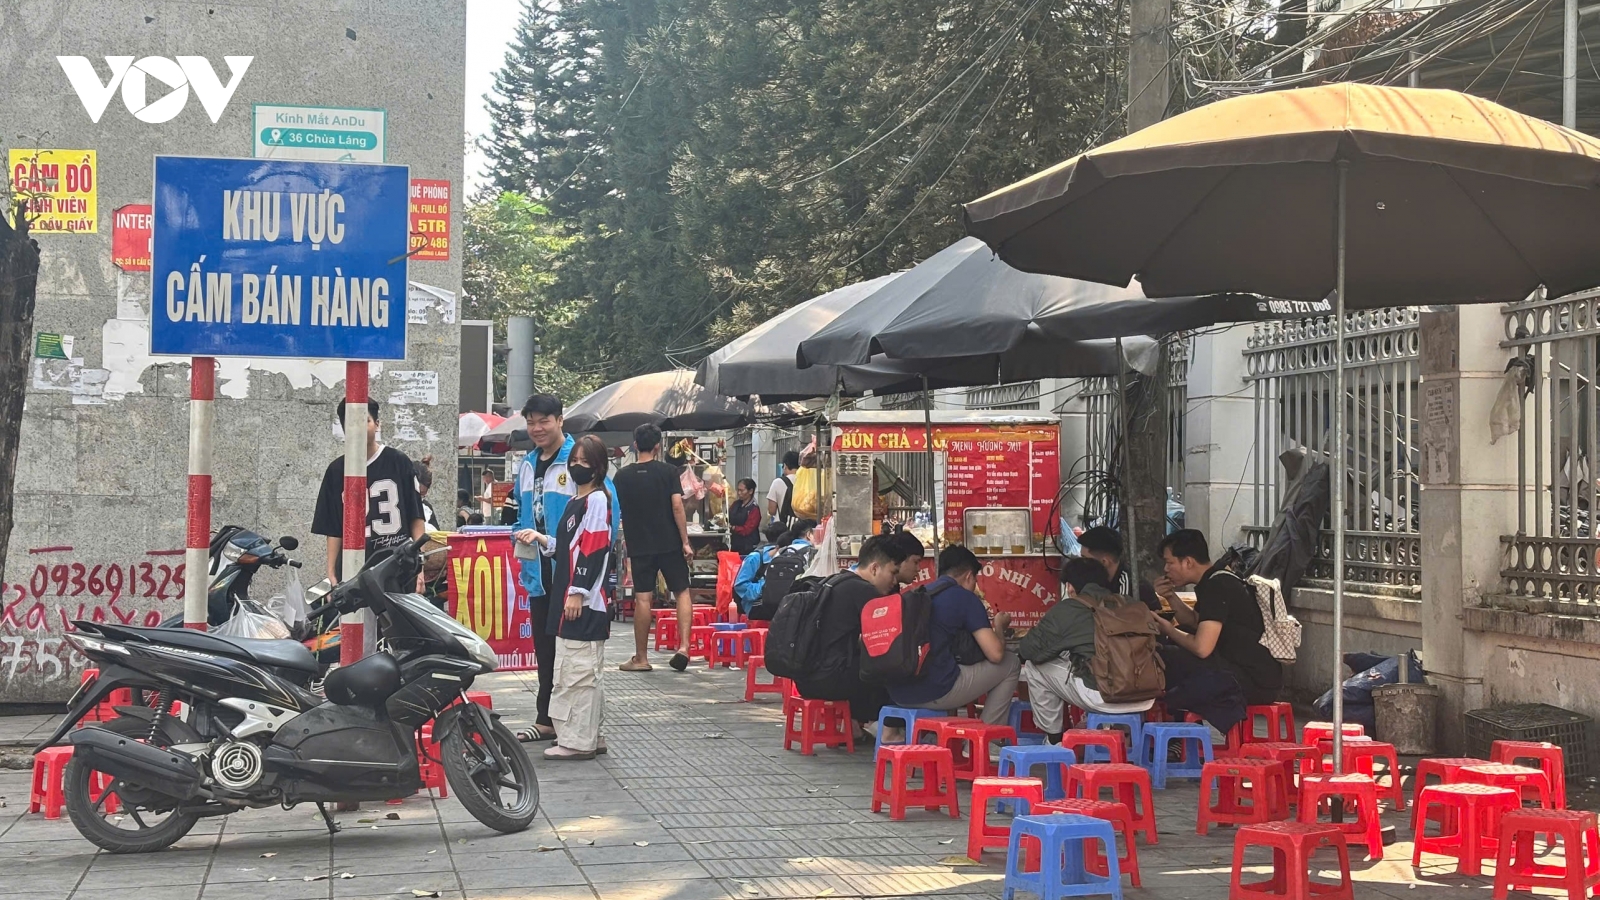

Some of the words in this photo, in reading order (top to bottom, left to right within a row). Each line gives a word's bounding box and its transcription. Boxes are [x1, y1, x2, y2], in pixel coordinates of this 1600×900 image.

[275, 112, 303, 124] Kính
[307, 112, 329, 126] Mắt
[332, 115, 365, 127] AnDu
[289, 132, 303, 143] 36
[305, 133, 335, 145] Chùa
[338, 134, 367, 148] Láng
[410, 184, 421, 199] UÊ
[423, 184, 448, 200] PHÒNG
[56, 196, 87, 214] VIÊN
[421, 204, 437, 214] FULL
[66, 216, 94, 232] GIẤY
[222, 189, 281, 242] KHU
[290, 188, 346, 251] VỰC
[418, 219, 447, 233] 5TR
[430, 236, 448, 249] 486
[166, 254, 232, 324] CẤM
[242, 265, 302, 326] BÁN
[310, 267, 390, 329] HÀNG
[1269, 300, 1292, 313] 0983
[841, 428, 875, 449] BÚN
[878, 427, 911, 449] CHẢ
[951, 441, 973, 452] MENU
[365, 478, 402, 537] 3
[998, 567, 1033, 589] NHĨ
[452, 538, 503, 641] XÔI
